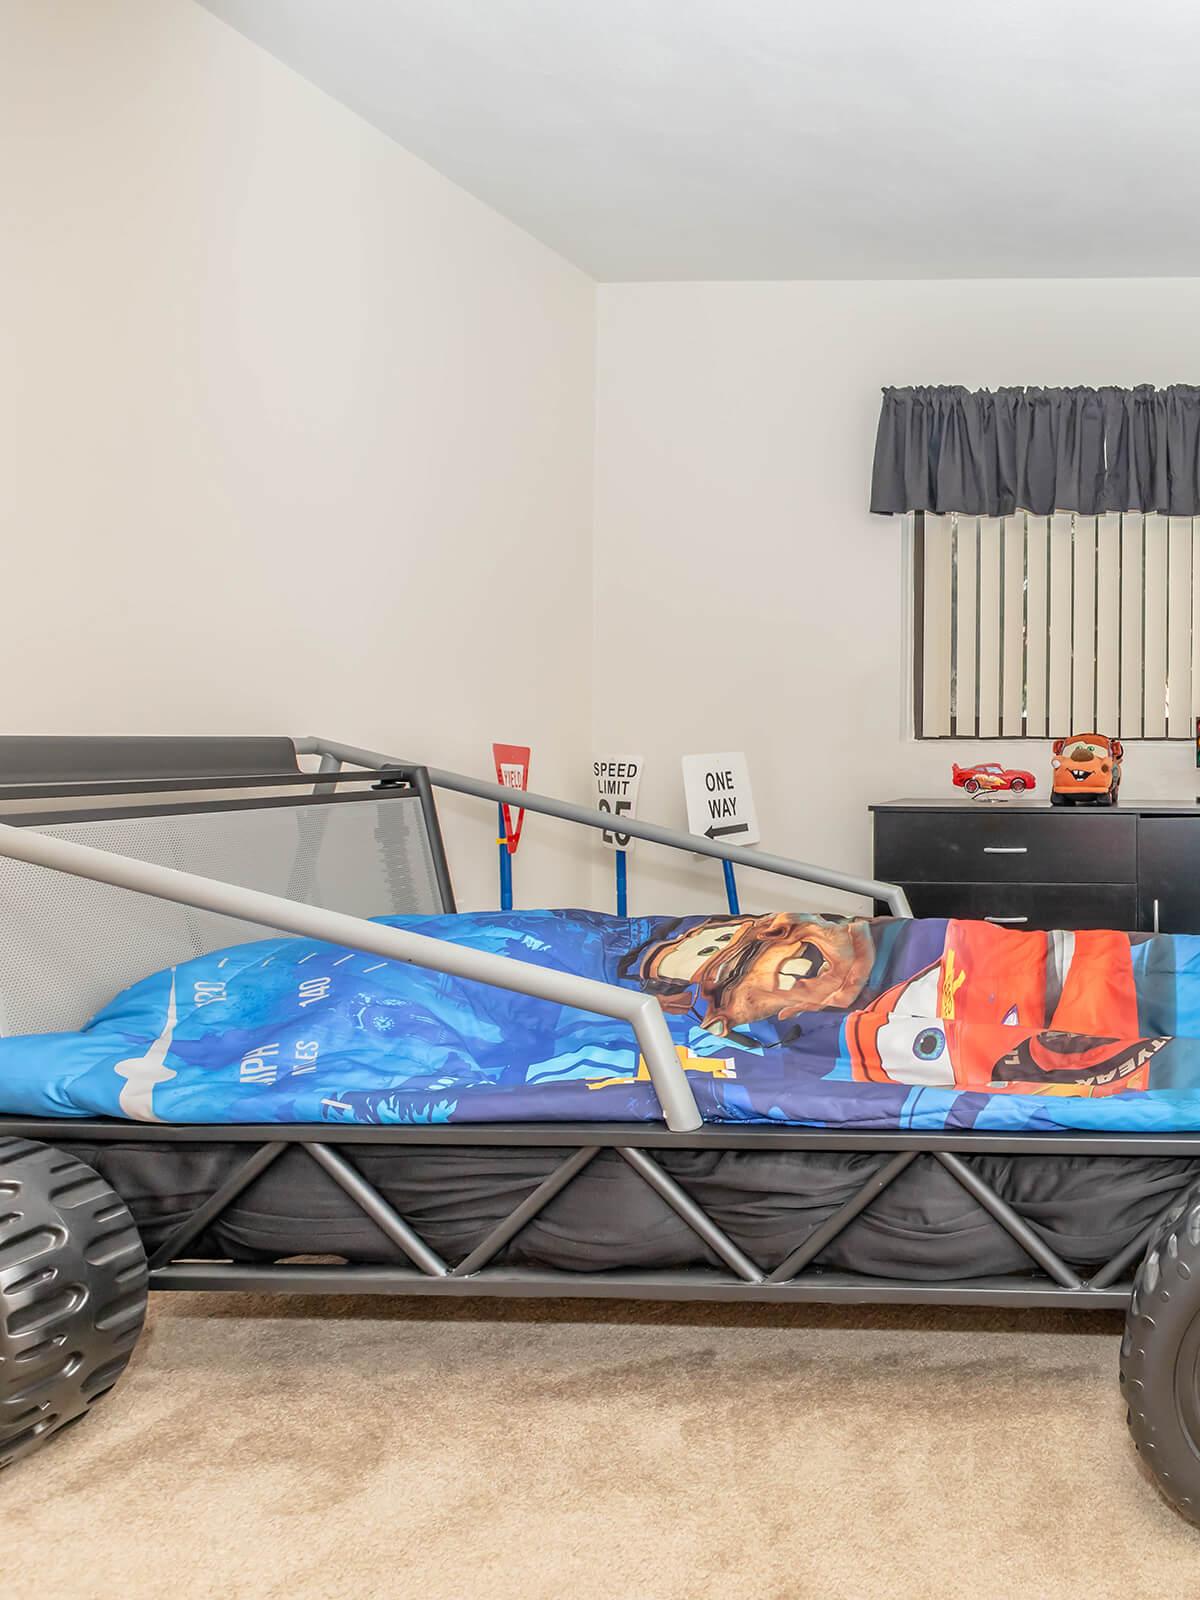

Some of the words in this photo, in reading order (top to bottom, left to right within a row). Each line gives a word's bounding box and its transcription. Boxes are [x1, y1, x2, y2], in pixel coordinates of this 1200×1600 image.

[503, 769, 523, 788] YIELD
[593, 761, 638, 778] SPEED
[597, 779, 630, 796] LIMIT
[705, 771, 734, 792] ONE
[707, 797, 738, 819] WAY
[298, 976, 332, 1008] 140
